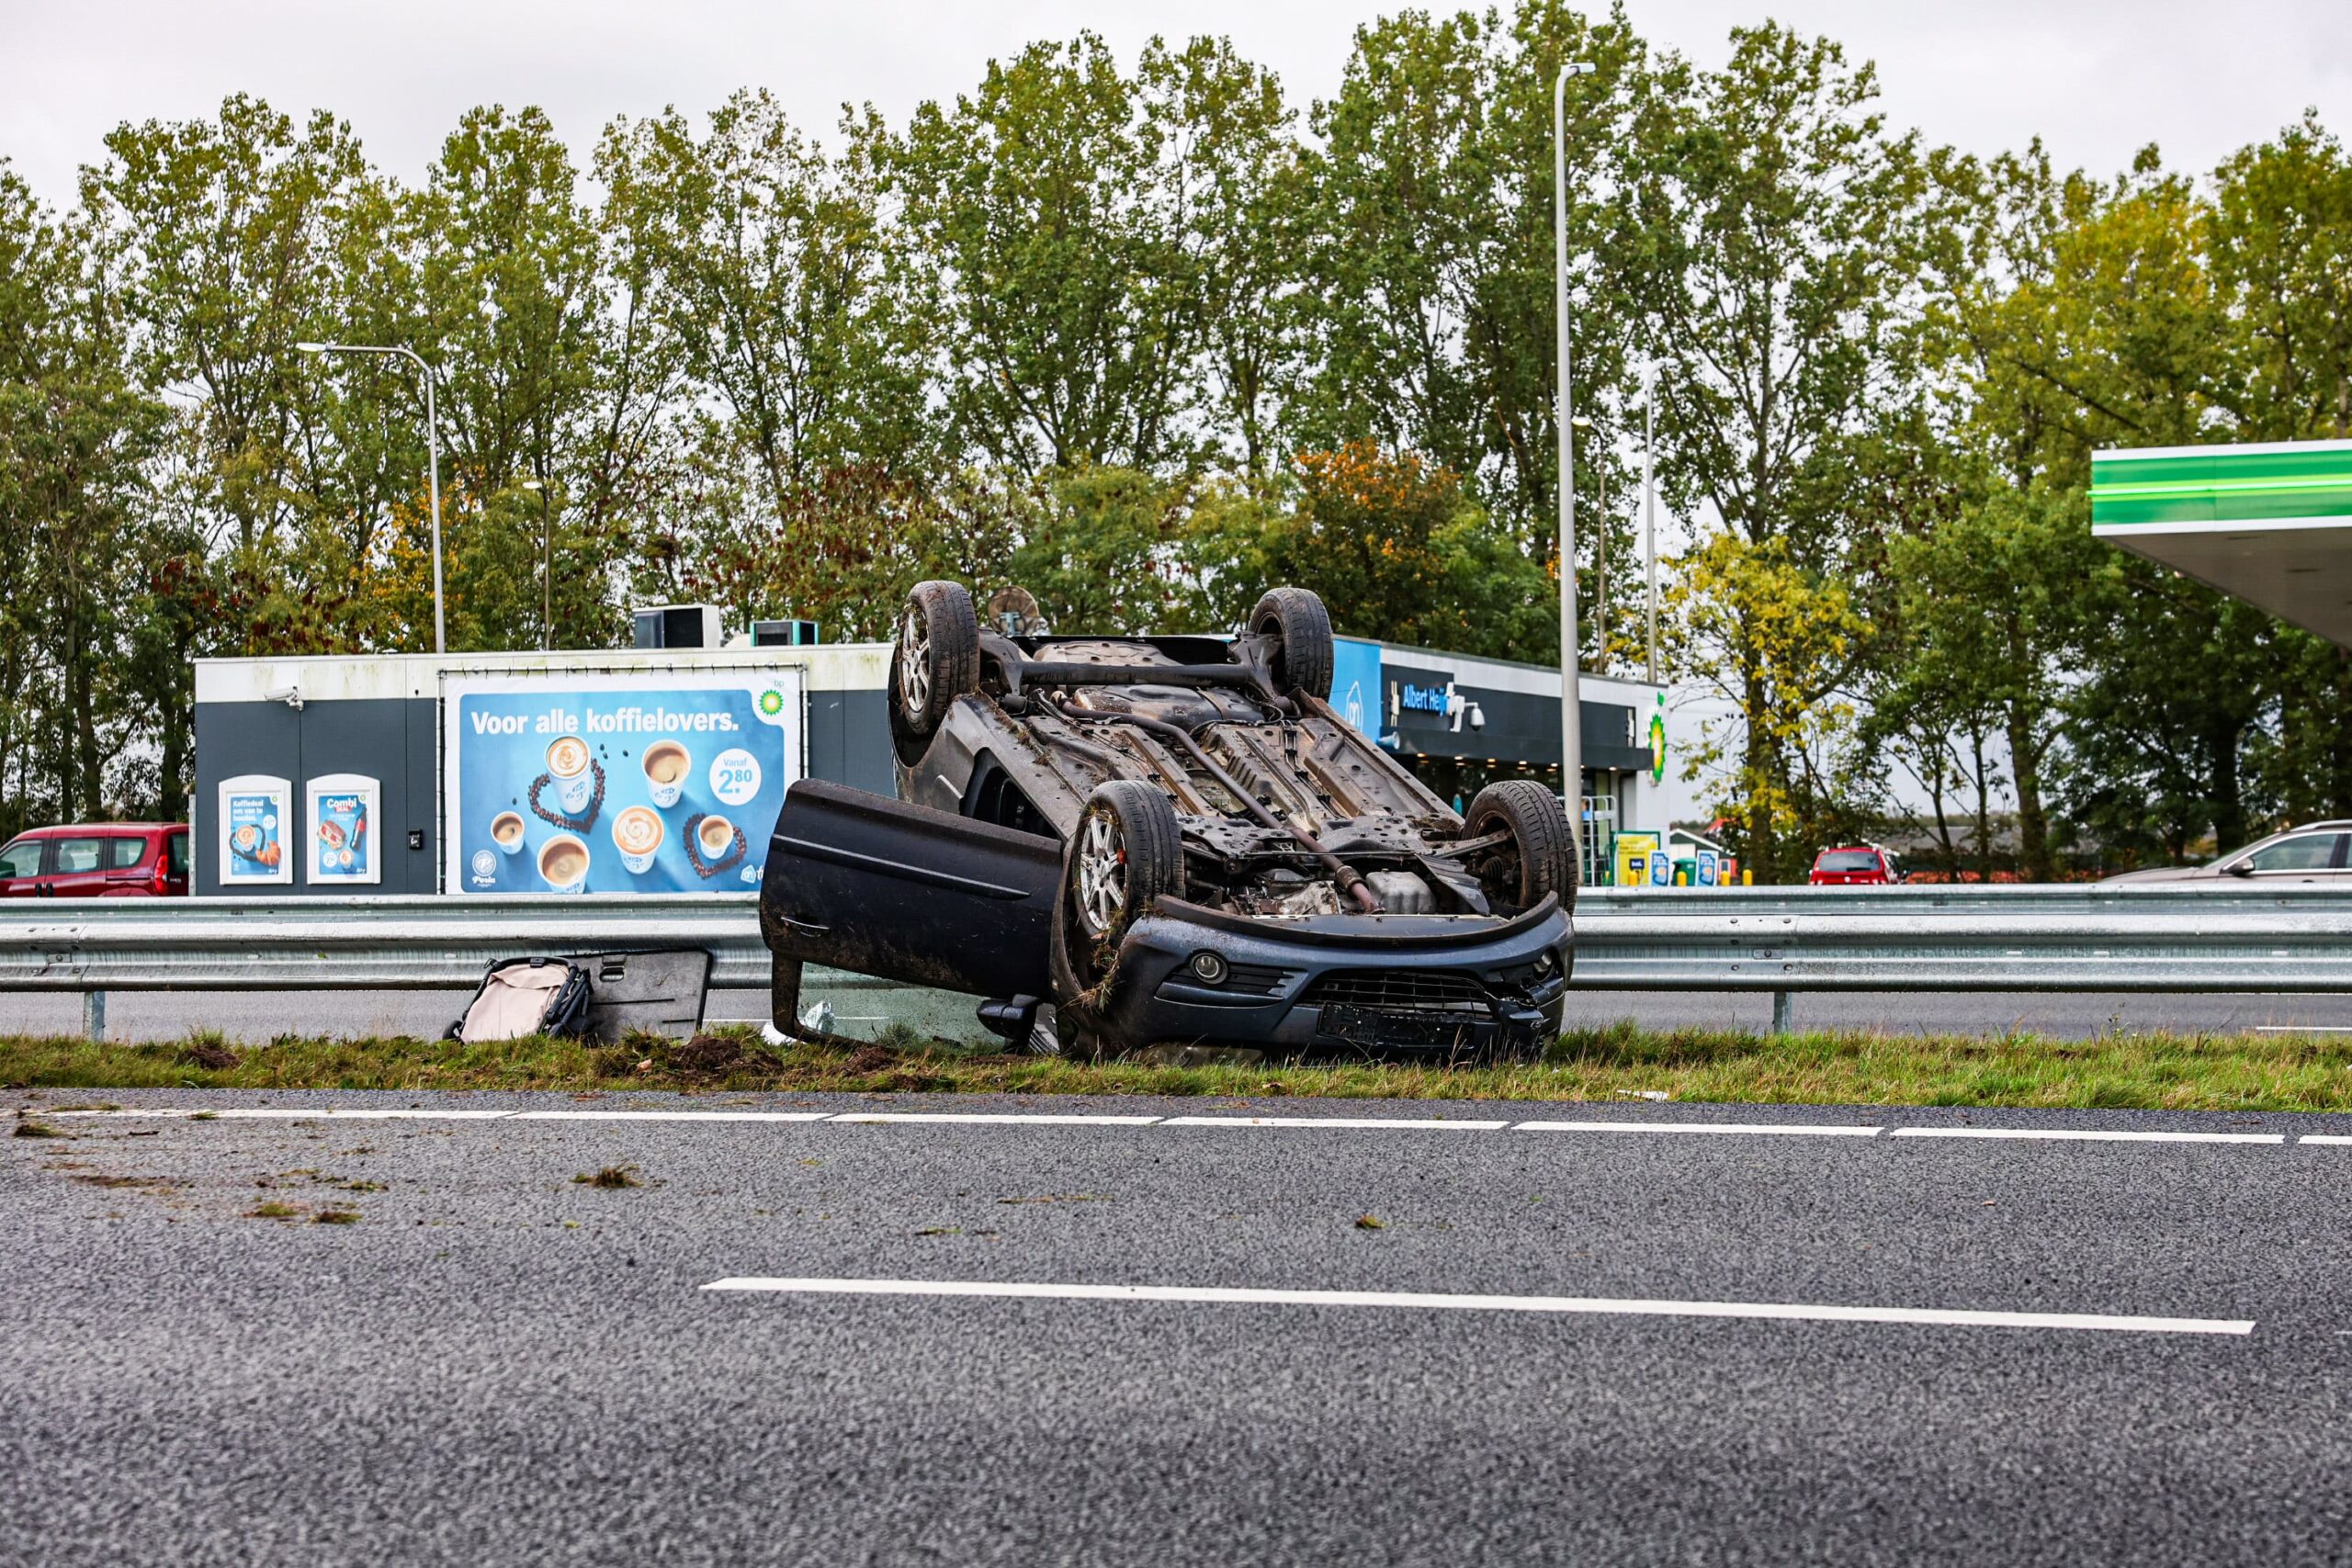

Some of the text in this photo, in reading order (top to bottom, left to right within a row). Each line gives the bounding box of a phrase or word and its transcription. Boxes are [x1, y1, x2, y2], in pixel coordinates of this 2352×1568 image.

[1403, 683, 1428, 710] Albert
[471, 707, 739, 735] Voor alle koffielovers.
[723, 758, 748, 766] Vanaf
[233, 799, 265, 807] Koffiedeal
[326, 797, 357, 808] Combi
